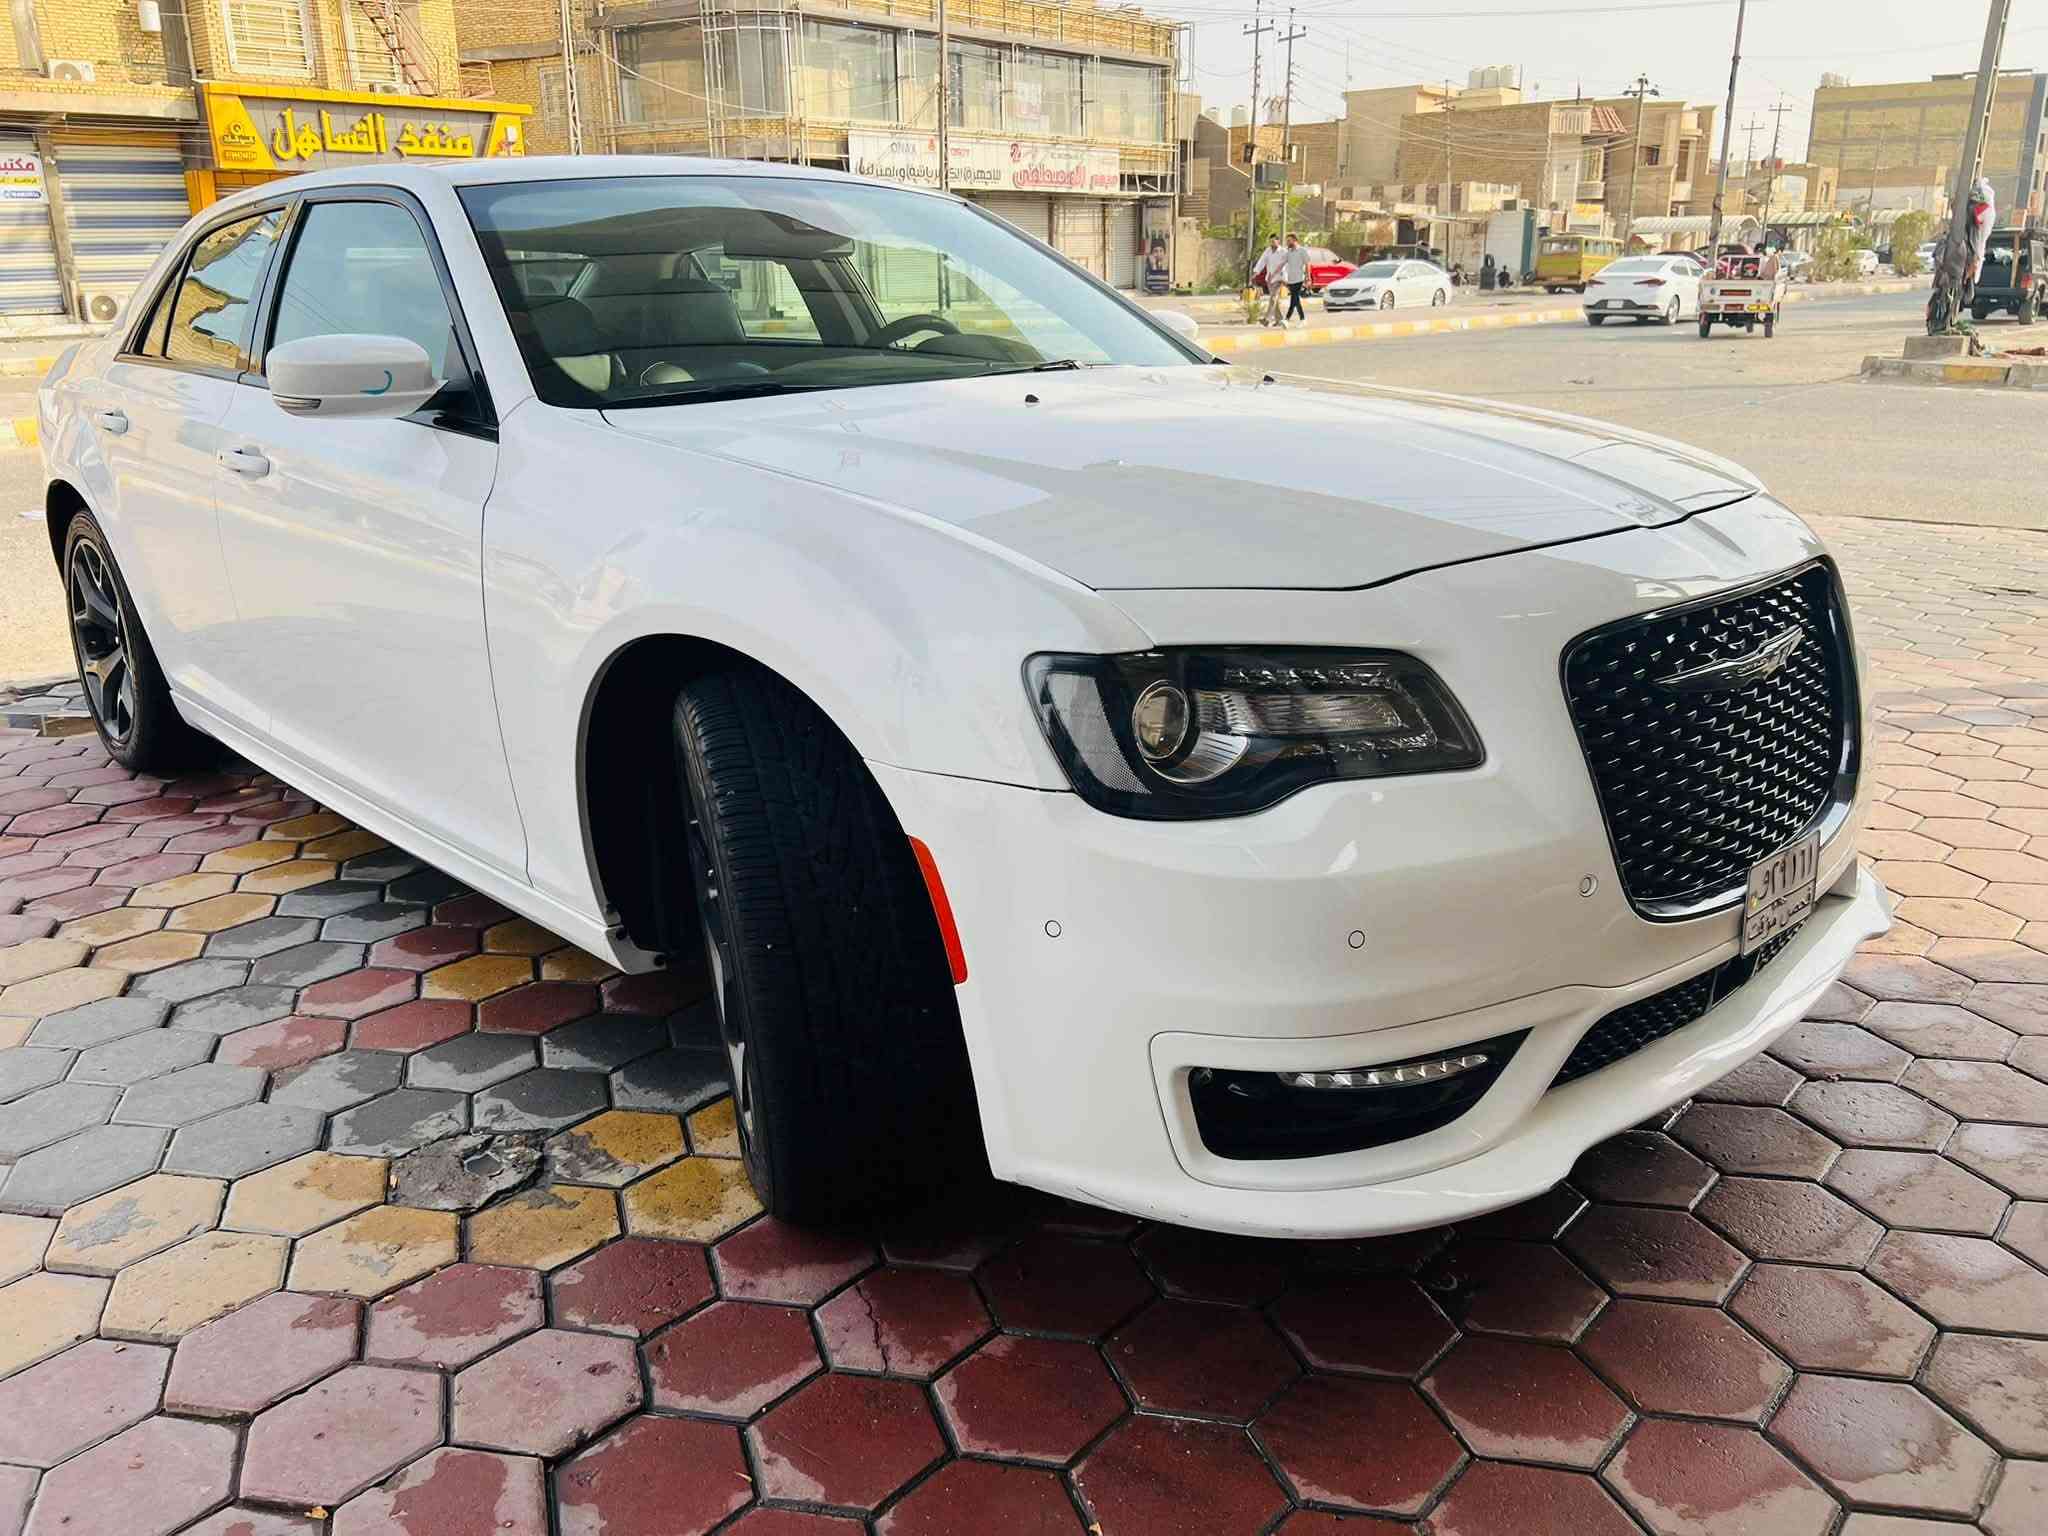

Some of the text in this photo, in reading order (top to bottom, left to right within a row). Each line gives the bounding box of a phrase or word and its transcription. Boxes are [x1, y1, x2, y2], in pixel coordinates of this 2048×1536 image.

[273, 105, 474, 161] منفذ التساهل
[0, 157, 35, 175] مكتب
